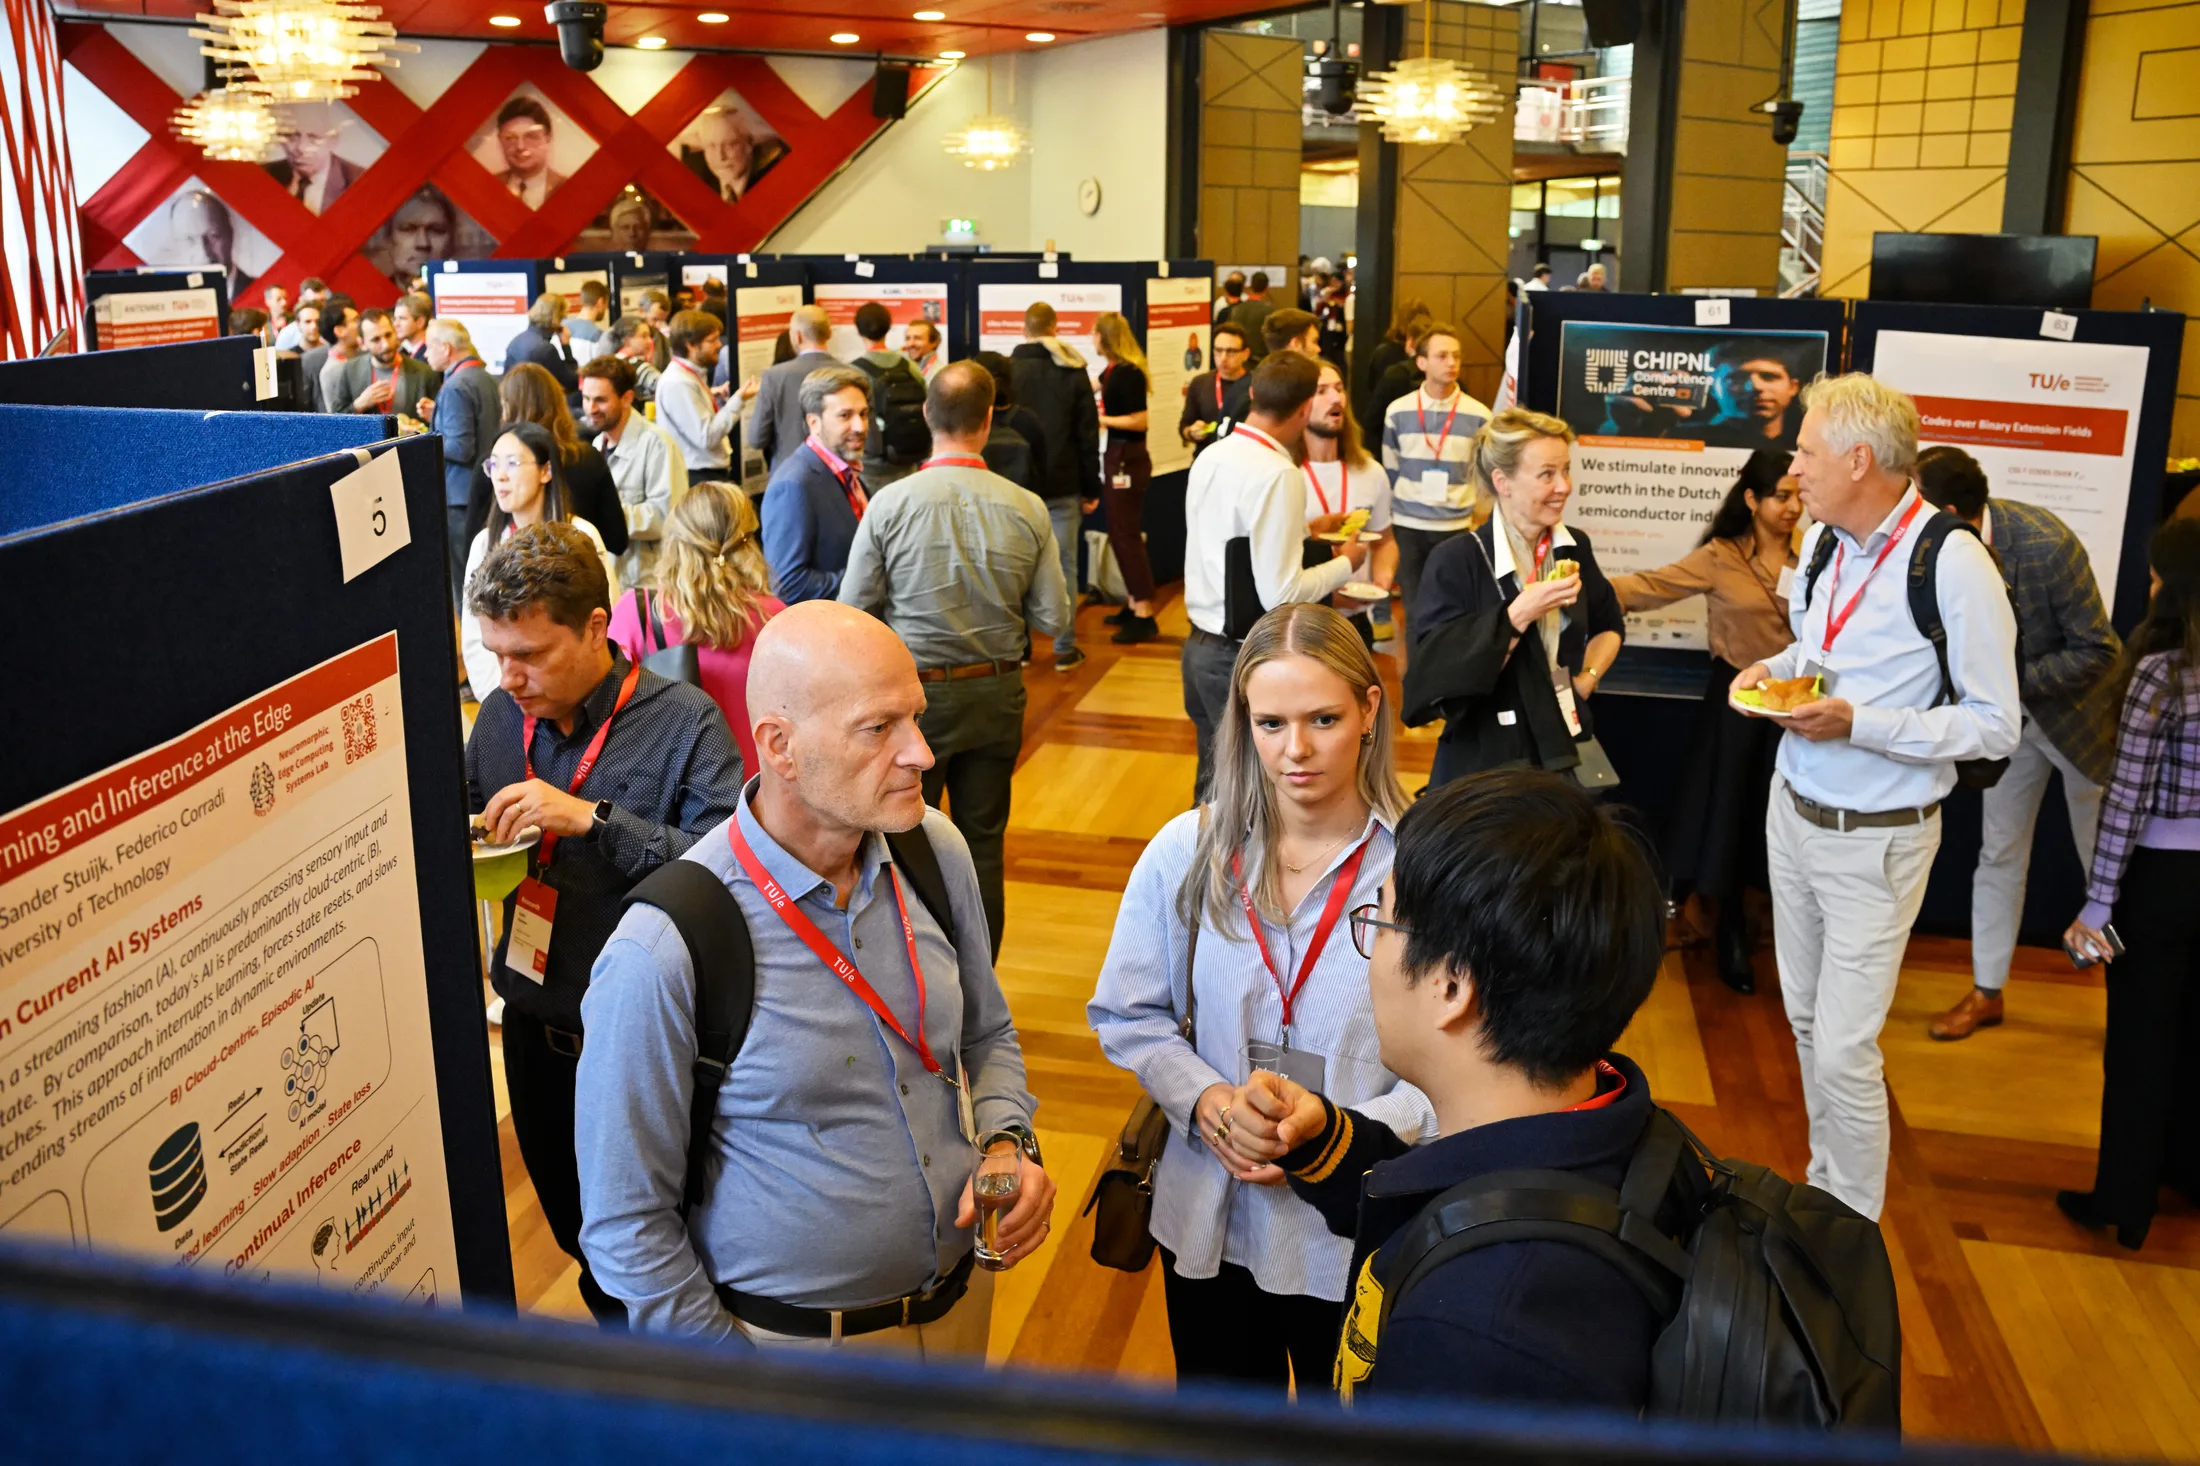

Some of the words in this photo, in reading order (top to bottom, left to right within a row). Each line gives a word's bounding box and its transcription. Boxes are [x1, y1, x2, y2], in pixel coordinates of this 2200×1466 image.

[1708, 306, 1721, 317] 61
[1633, 350, 1715, 372] CHIPNL
[1633, 370, 1714, 385] Competence
[1632, 384, 1676, 397] Centre
[2028, 373, 2070, 392] TU/e
[1921, 415, 1952, 427] Codes
[1954, 419, 1976, 429] over
[1978, 419, 2011, 434] Binary
[2012, 421, 2062, 436] Extension
[2063, 425, 2092, 438] Fields
[1581, 458, 1605, 471] We
[1608, 459, 1677, 475] stimulate
[1579, 482, 1631, 496] growth
[1635, 483, 1648, 496] in
[1651, 484, 1675, 498] the
[1679, 486, 1721, 500] Dutch
[372, 496, 387, 537] 5
[1578, 505, 1686, 521] semiconductor
[278, 726, 329, 761] Neuromorphic
[278, 765, 294, 780] Edge
[295, 740, 334, 769] Computing
[0, 822, 61, 869] ning
[63, 791, 107, 839] and
[108, 751, 204, 816] Inference
[205, 735, 224, 766] at
[225, 724, 252, 755] the
[253, 703, 292, 738] Edge
[286, 769, 315, 793] Systems
[316, 761, 329, 774] Lab
[577, 761, 592, 780] TU/e
[0, 884, 59, 930] Sander
[63, 856, 114, 894] Stuijk,
[116, 820, 178, 865] Federico
[180, 786, 227, 828] Corradi
[67, 901, 84, 928] of
[87, 856, 171, 915] Technology
[763, 880, 785, 909] TU/e
[902, 915, 913, 942] TU/e
[10, 1068, 20, 1087] a
[24, 1014, 100, 1078] streaming
[103, 977, 153, 1025] fashion
[156, 957, 178, 987] (A),
[180, 905, 250, 968] continuously
[251, 866, 304, 918] processing
[305, 842, 343, 877] sensory
[344, 824, 370, 852] input
[371, 809, 388, 833] and
[17, 957, 101, 1025] Current
[105, 940, 124, 972] AI
[128, 894, 203, 954] Systems
[43, 1070, 63, 1097] By
[67, 1010, 153, 1079] comparison,
[156, 971, 199, 1016] today's
[201, 958, 214, 983] AI
[216, 953, 225, 970] is
[226, 896, 301, 966] predominantly
[303, 851, 366, 905] cloud-centric
[833, 956, 855, 983] TU/e
[52, 1088, 84, 1121] This
[87, 1037, 154, 1097] approach
[156, 992, 214, 1047] interrupts
[215, 956, 261, 1000] learning,
[263, 929, 294, 965] forces
[296, 909, 321, 938] state
[323, 888, 354, 918] resets,
[355, 873, 373, 895] and
[375, 854, 398, 881] slows
[302, 992, 326, 1015] Update
[69, 1090, 126, 1143] streams
[130, 1072, 143, 1097] of
[146, 1019, 216, 1085] information
[218, 1008, 229, 1027] in
[230, 971, 275, 1016] dynamic
[276, 919, 347, 978] environments.
[170, 1085, 182, 1106] B)
[185, 1024, 259, 1092] Cloud-Centric,
[261, 988, 303, 1028] Episodic
[304, 975, 315, 994] AI
[228, 1089, 246, 1113] Read
[299, 1117, 306, 1131] AI
[307, 1098, 327, 1123] model
[202, 1199, 245, 1248] learning
[253, 1168, 277, 1197] Slow
[279, 1128, 320, 1172] adaption
[328, 1099, 352, 1126] State
[353, 1082, 371, 1104] loss
[230, 1155, 248, 1176] State
[249, 1134, 269, 1158] Reset
[351, 1167, 370, 1196] Real
[372, 1145, 394, 1176] world
[224, 1198, 296, 1278] Continual
[296, 1138, 361, 1208] Inference
[175, 1228, 193, 1250] Data
[353, 1240, 397, 1292] continuous
[396, 1217, 416, 1245] input
[379, 1252, 403, 1283] Linear
[403, 1233, 416, 1256] and
